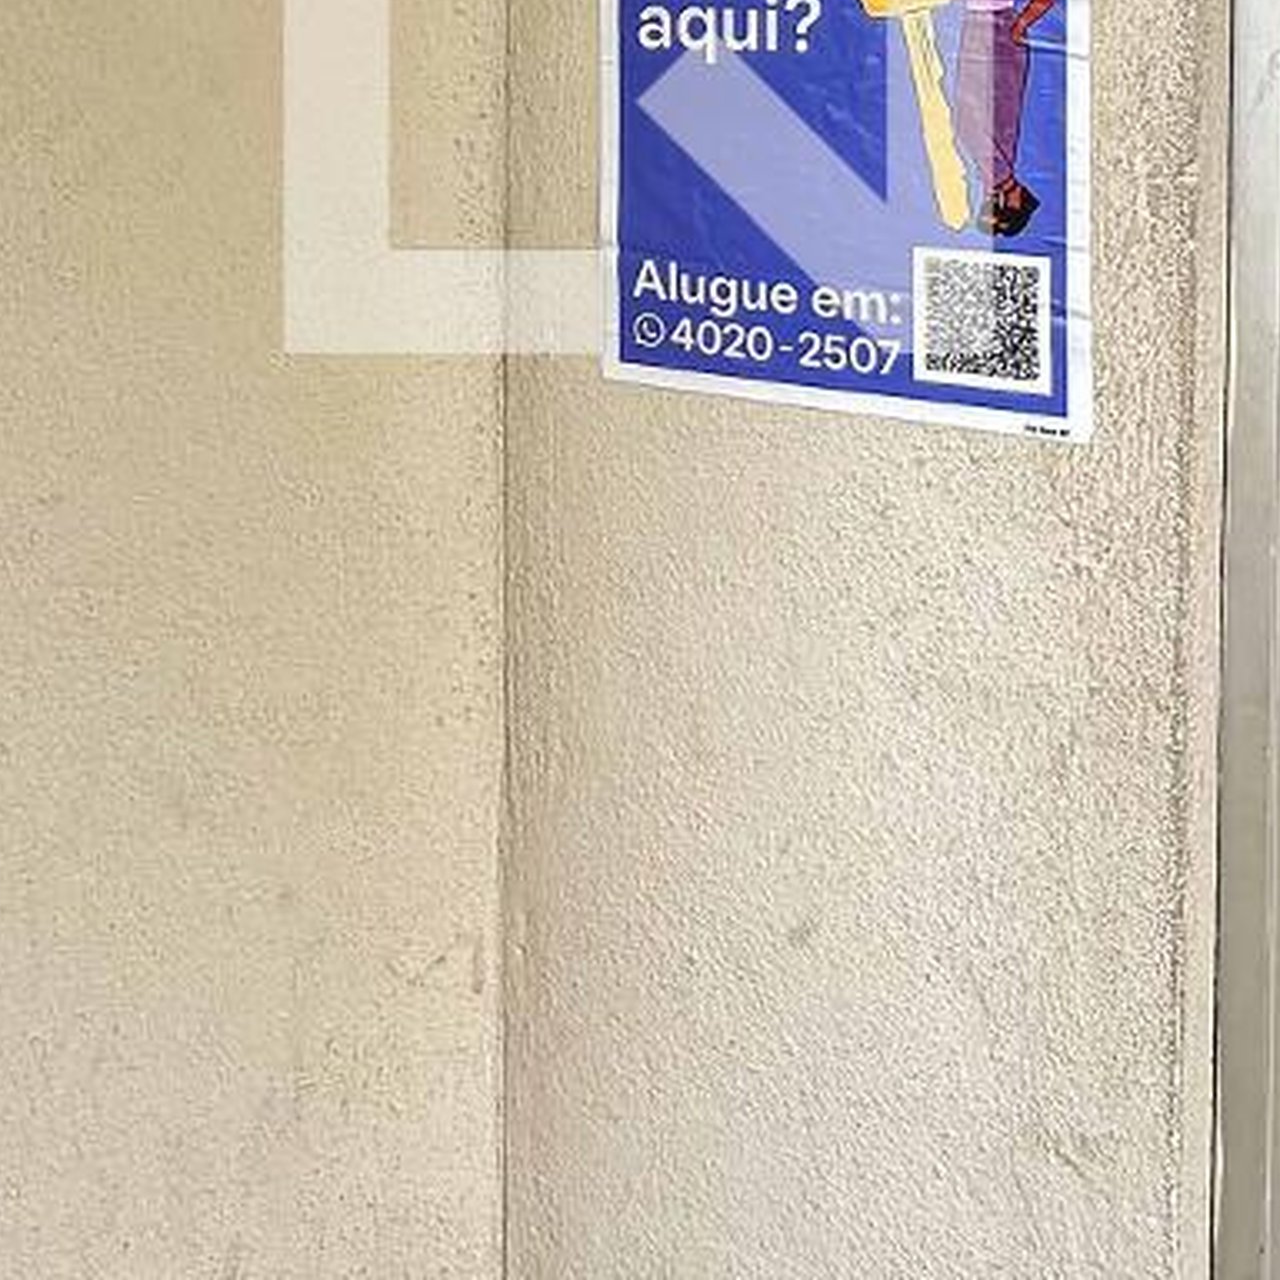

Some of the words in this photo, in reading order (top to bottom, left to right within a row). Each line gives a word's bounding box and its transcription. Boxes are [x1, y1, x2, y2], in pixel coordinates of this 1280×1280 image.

[633, 259, 799, 317] Alugue
[811, 283, 903, 326] em:
[670, 317, 901, 375] 4020-2507
